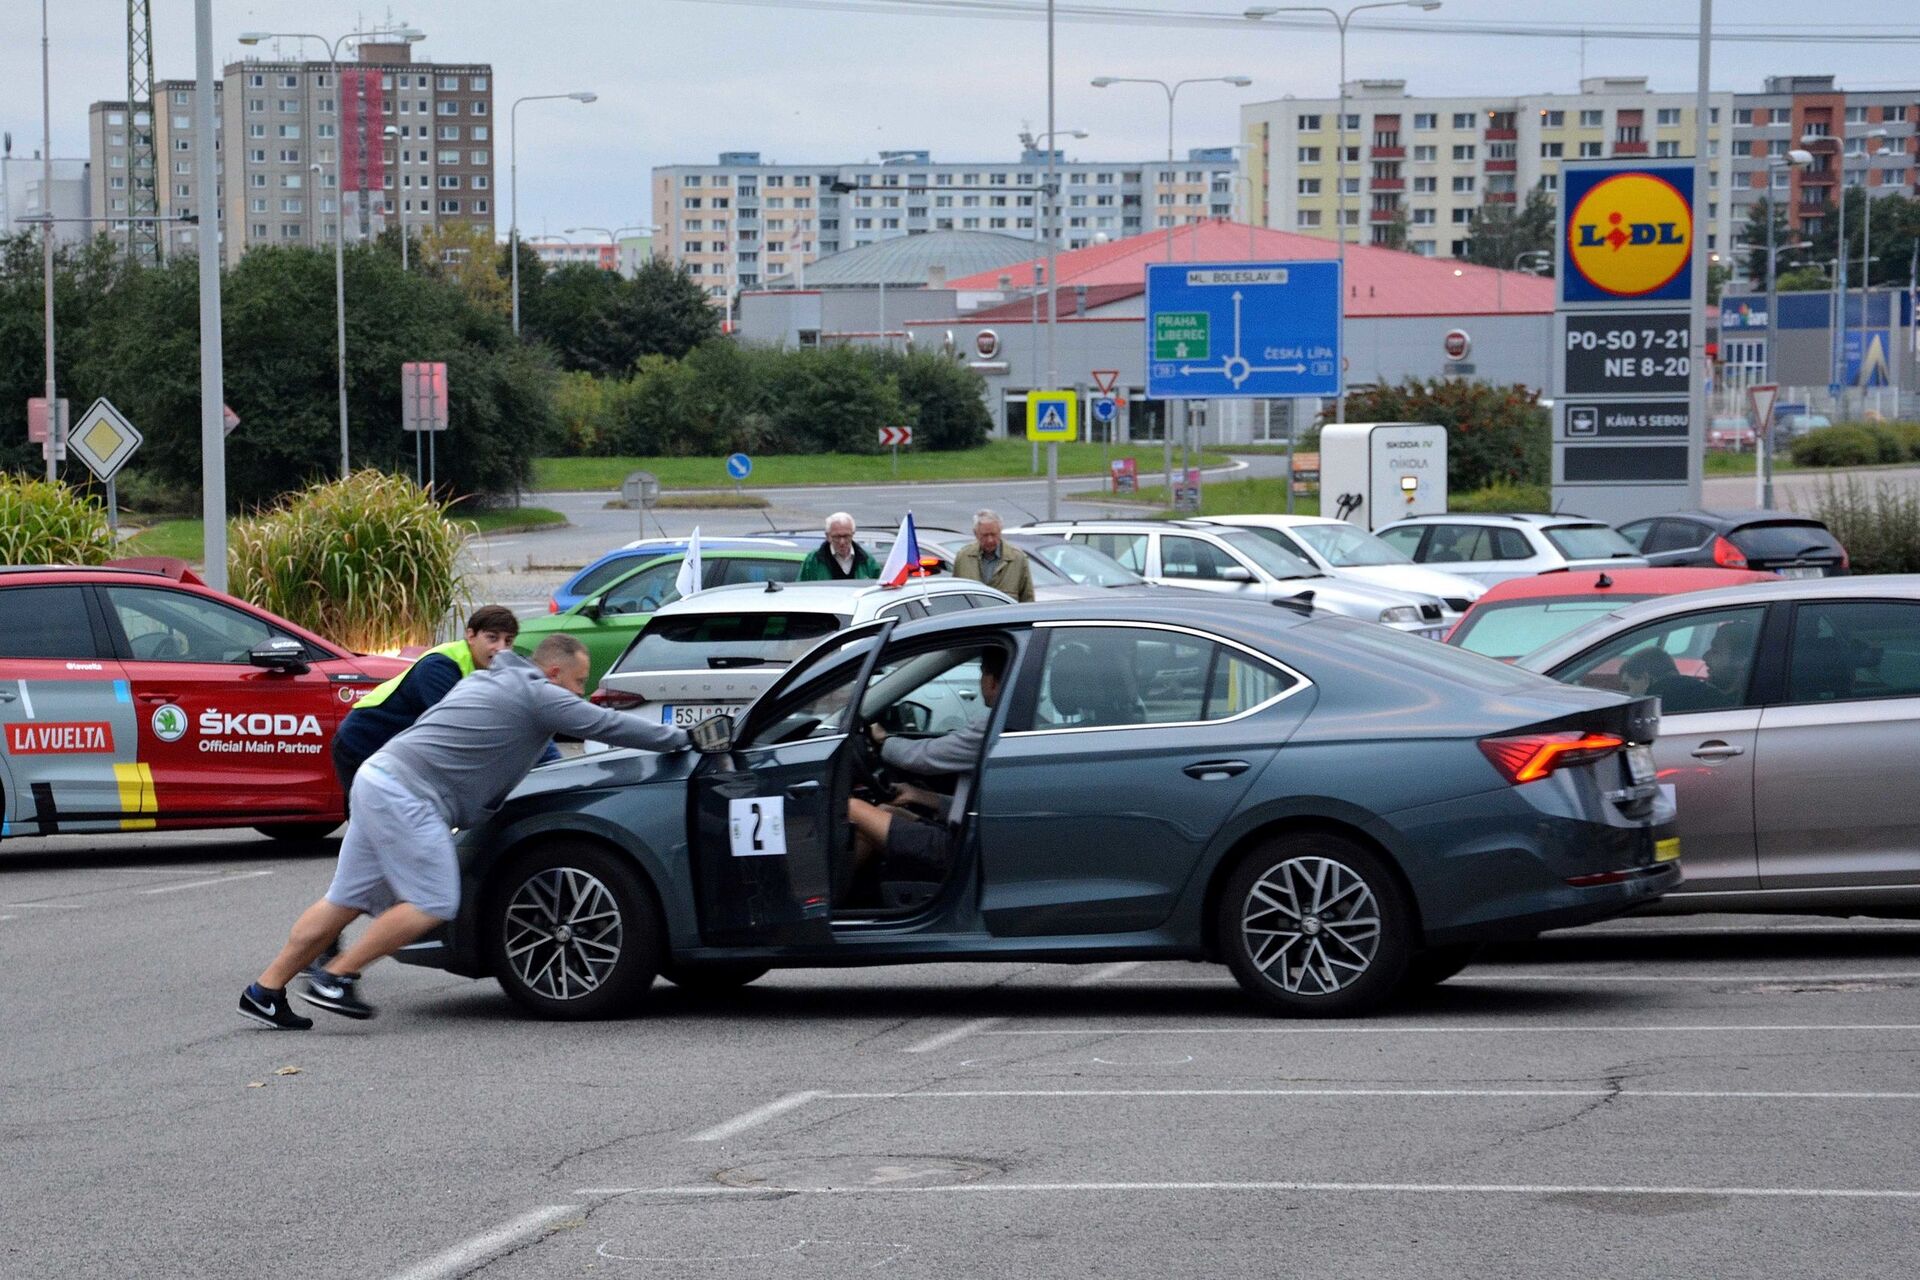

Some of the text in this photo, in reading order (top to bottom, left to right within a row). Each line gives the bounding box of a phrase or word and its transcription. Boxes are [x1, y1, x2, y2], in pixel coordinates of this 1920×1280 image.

[1213, 271, 1270, 282] BOLESLAV
[1157, 316, 1197, 326] PRAHA
[1157, 330, 1206, 340] LIBEREC
[1567, 329, 1689, 350] PO-SO 7-21
[1264, 346, 1333, 360] ČESKÁ LÍPA
[1605, 357, 1690, 377] NE 8-20
[1605, 413, 1689, 427] KÁVA S SEBOU
[199, 707, 323, 737] ŠKODA
[675, 707, 703, 724] 5SJ
[15, 726, 105, 749] LA VUELTA
[199, 739, 322, 754] Official Main Partner
[751, 802, 764, 851] 2
